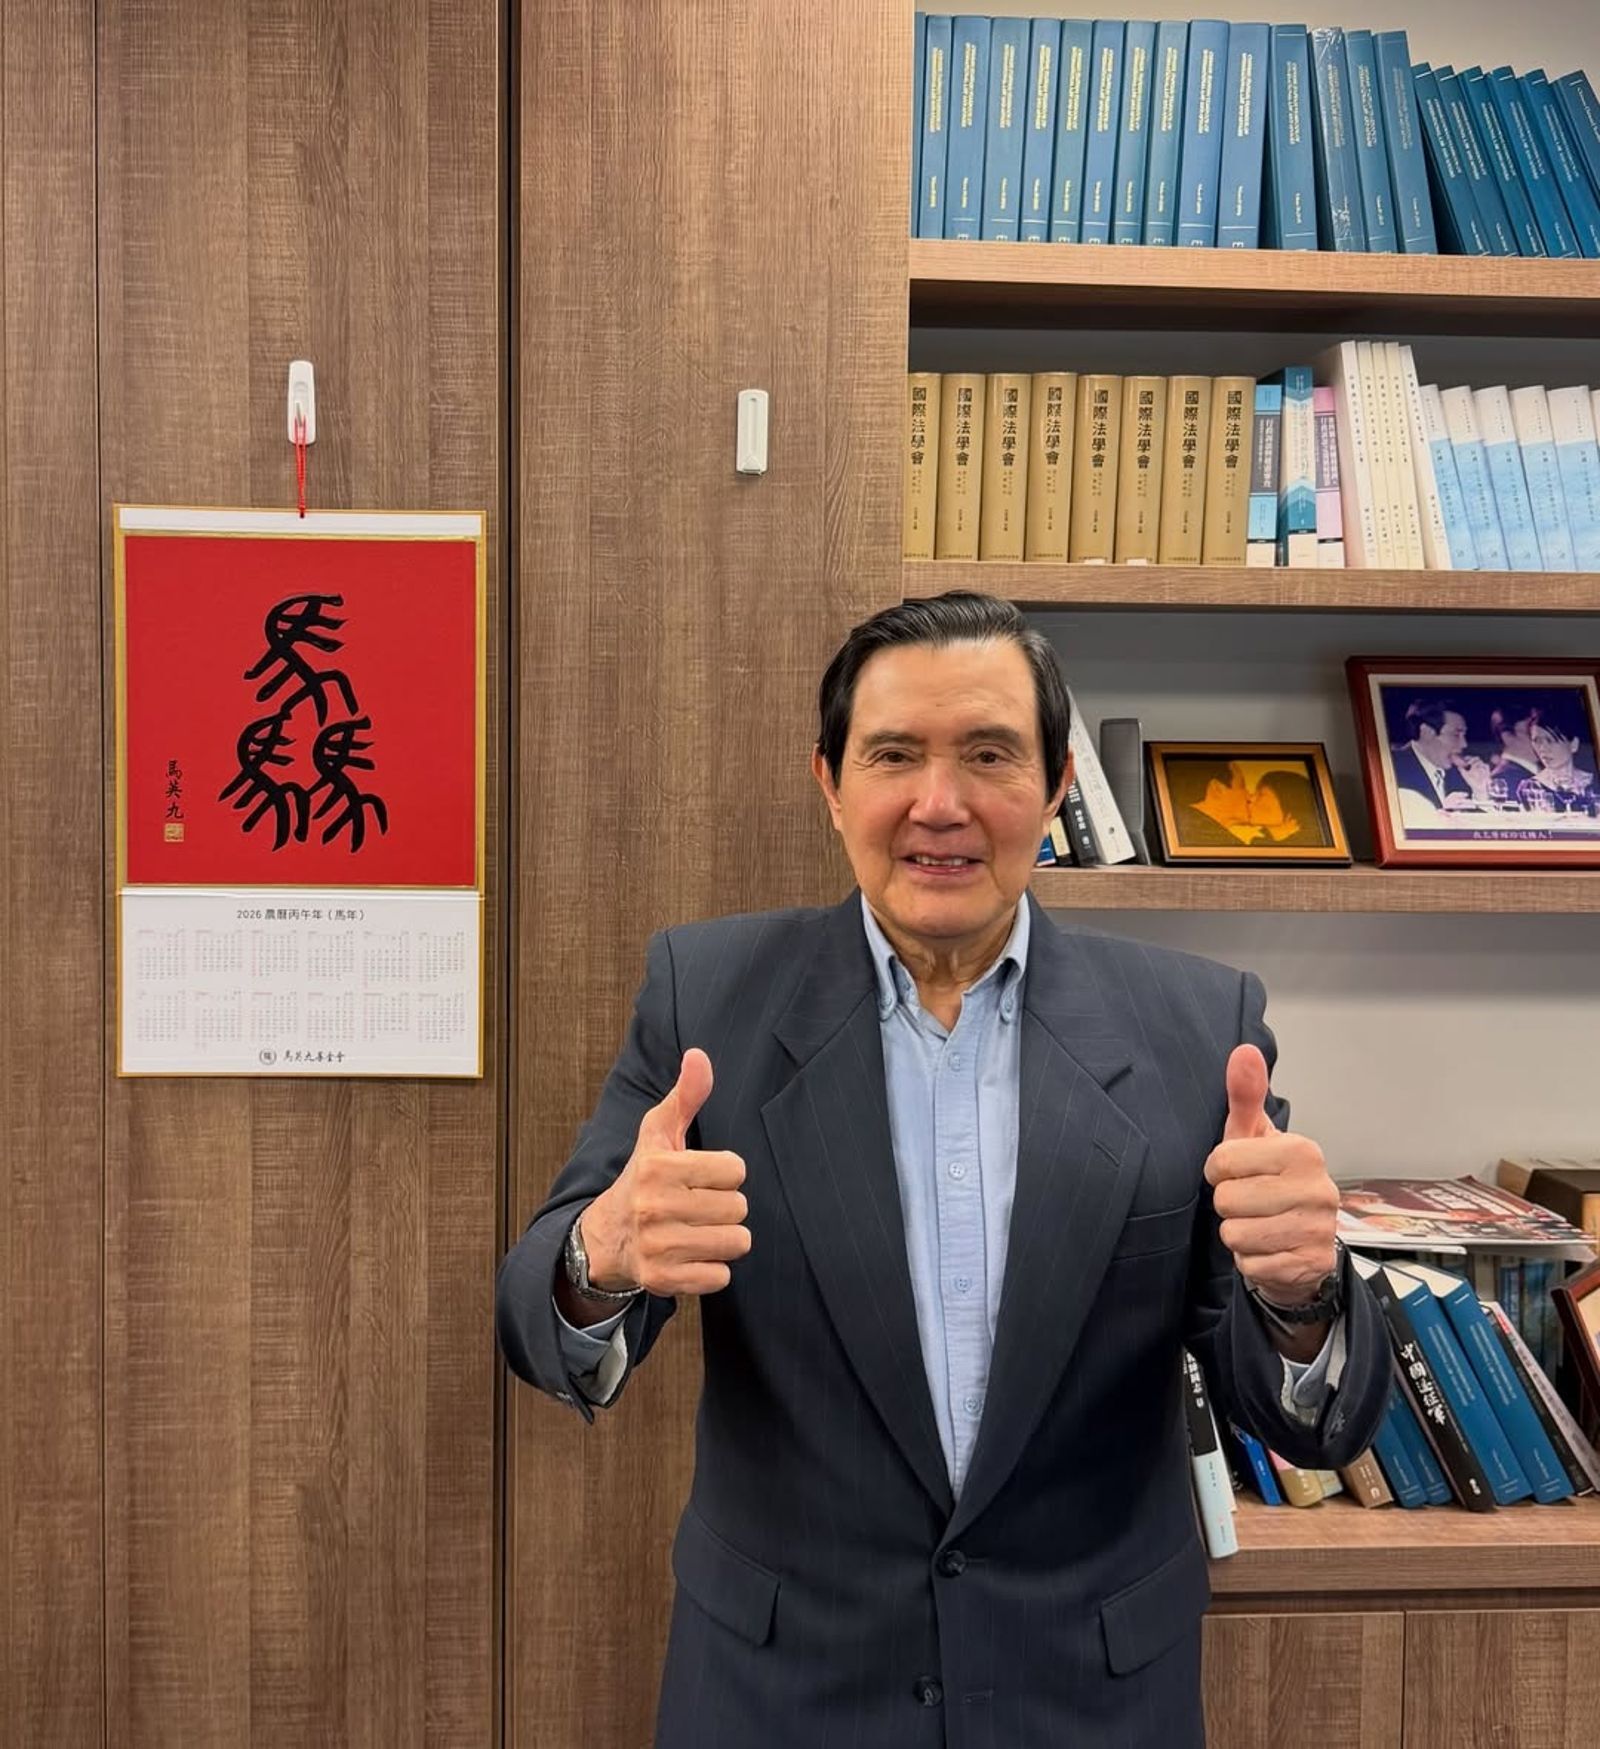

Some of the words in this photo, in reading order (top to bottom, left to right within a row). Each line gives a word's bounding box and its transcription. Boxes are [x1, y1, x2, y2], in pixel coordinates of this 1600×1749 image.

[910, 386, 927, 465] 國際法學會
[956, 387, 973, 466] 國際法學會
[1001, 388, 1018, 466] 國際法學會
[1045, 386, 1062, 465] 國際法學會
[1092, 389, 1108, 468] 國際法學會
[1137, 390, 1154, 469] 國際法學會
[1182, 390, 1199, 469] 國際法學會
[1225, 390, 1242, 469] 國際法學會
[166, 759, 185, 819] 馬英九
[236, 909, 262, 920] 2026
